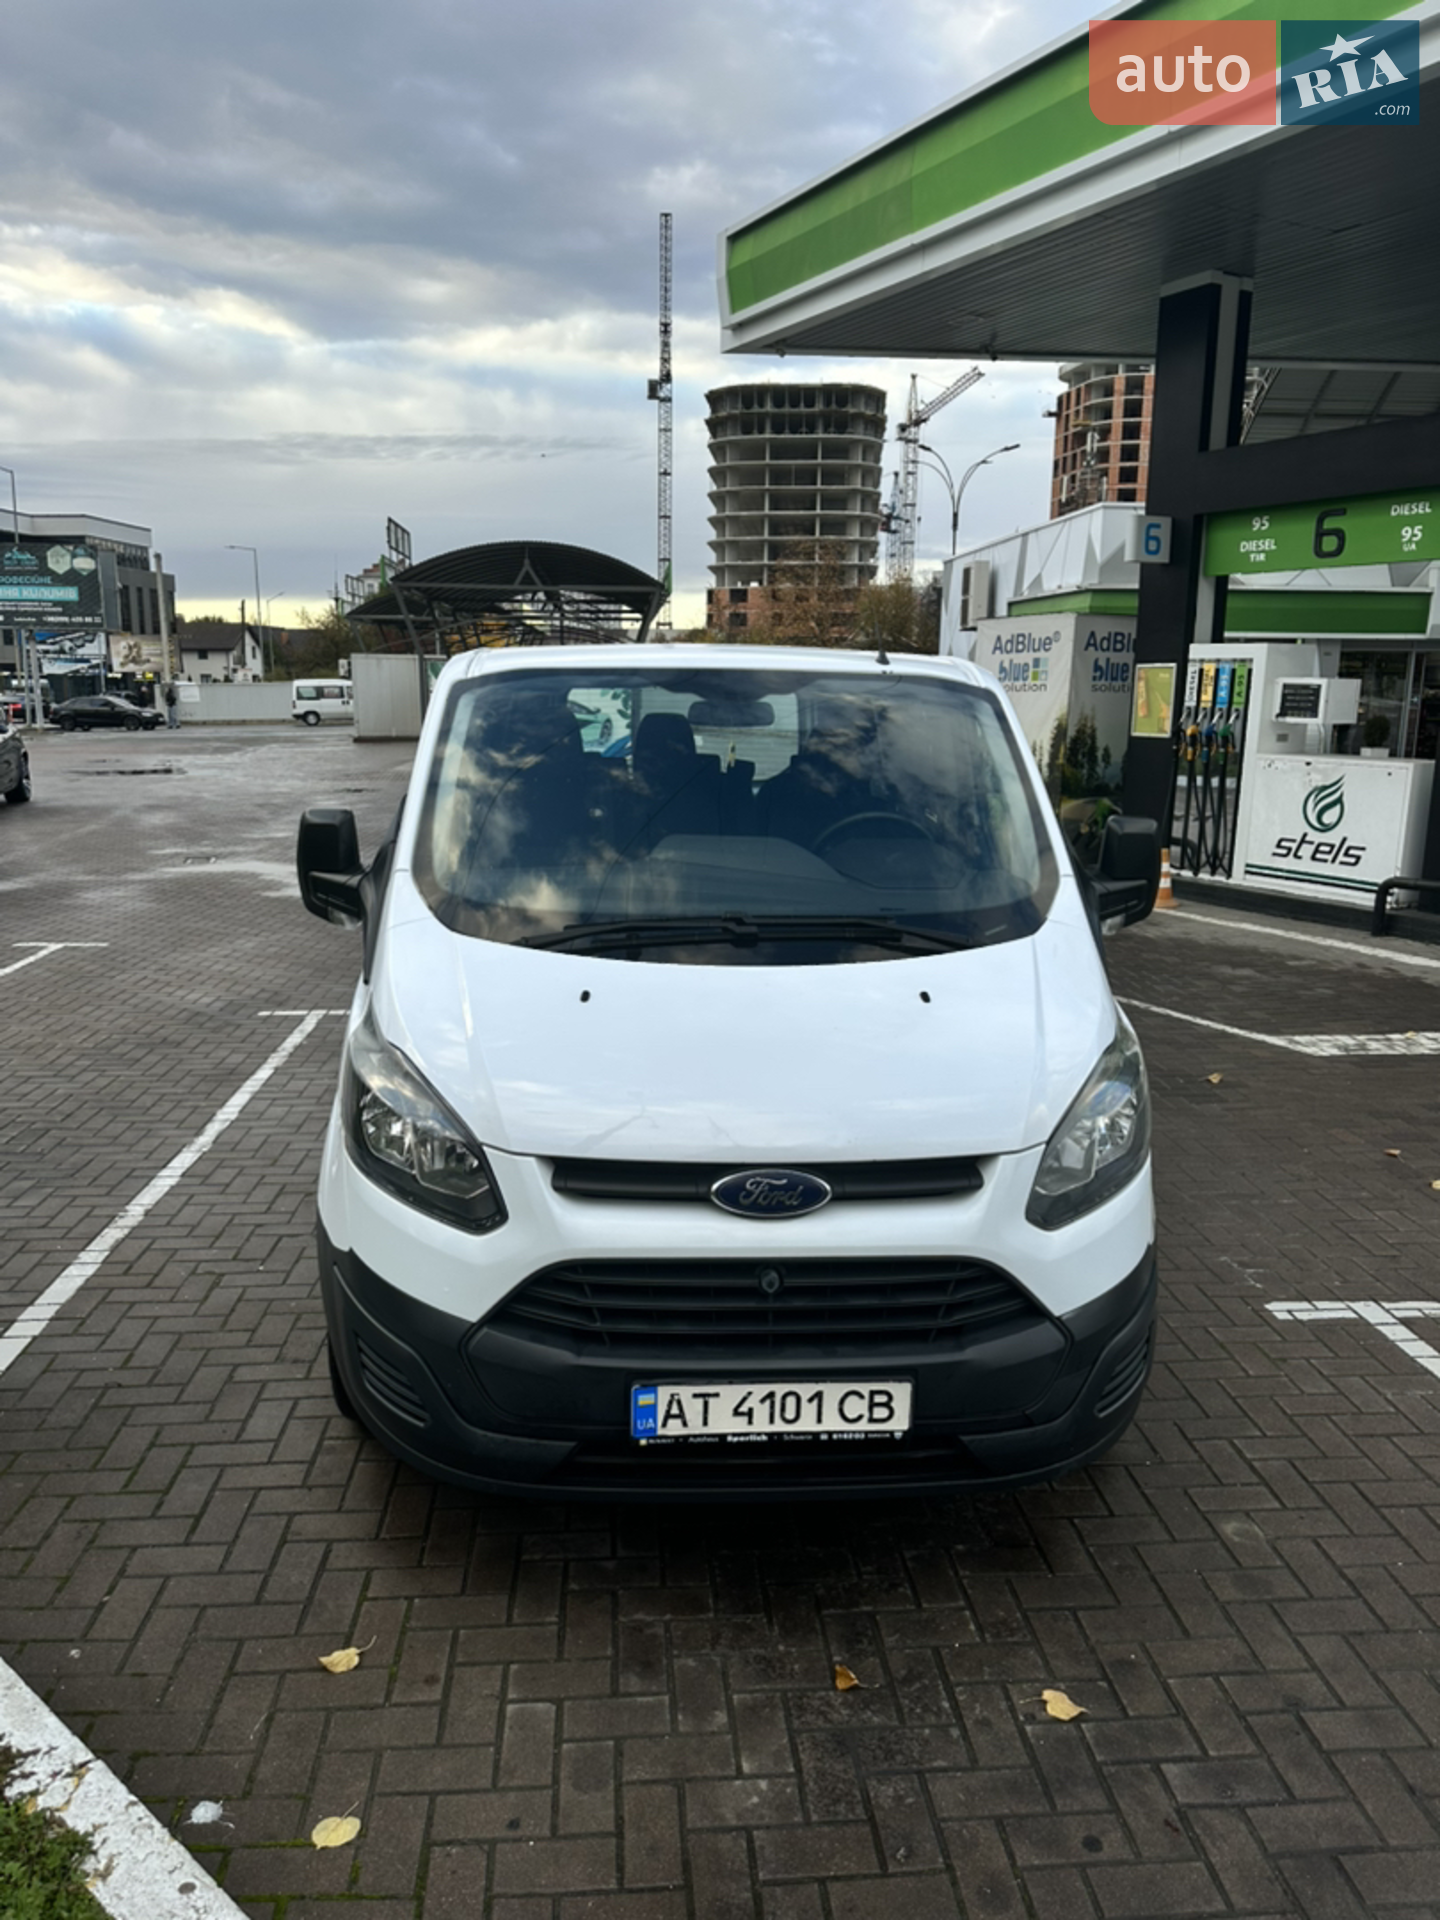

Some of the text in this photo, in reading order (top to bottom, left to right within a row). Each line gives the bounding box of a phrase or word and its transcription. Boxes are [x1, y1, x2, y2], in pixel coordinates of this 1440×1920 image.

[1390, 501, 1432, 517] DIESEL
[1251, 516, 1270, 531] 95
[1144, 522, 1162, 556] 6
[1313, 507, 1348, 559] 6
[1400, 525, 1423, 542] 95
[1239, 538, 1277, 552] DIESEL
[1402, 543, 1417, 551] UA
[1249, 553, 1266, 562] TIR
[998, 658, 1030, 682] blue
[1092, 657, 1130, 682] blue
[1003, 682, 1047, 692] olution
[1271, 832, 1367, 867] stels
[739, 1177, 804, 1206] Ford
[660, 1389, 895, 1428] AT 4101 CB
[637, 1418, 655, 1430] UA
